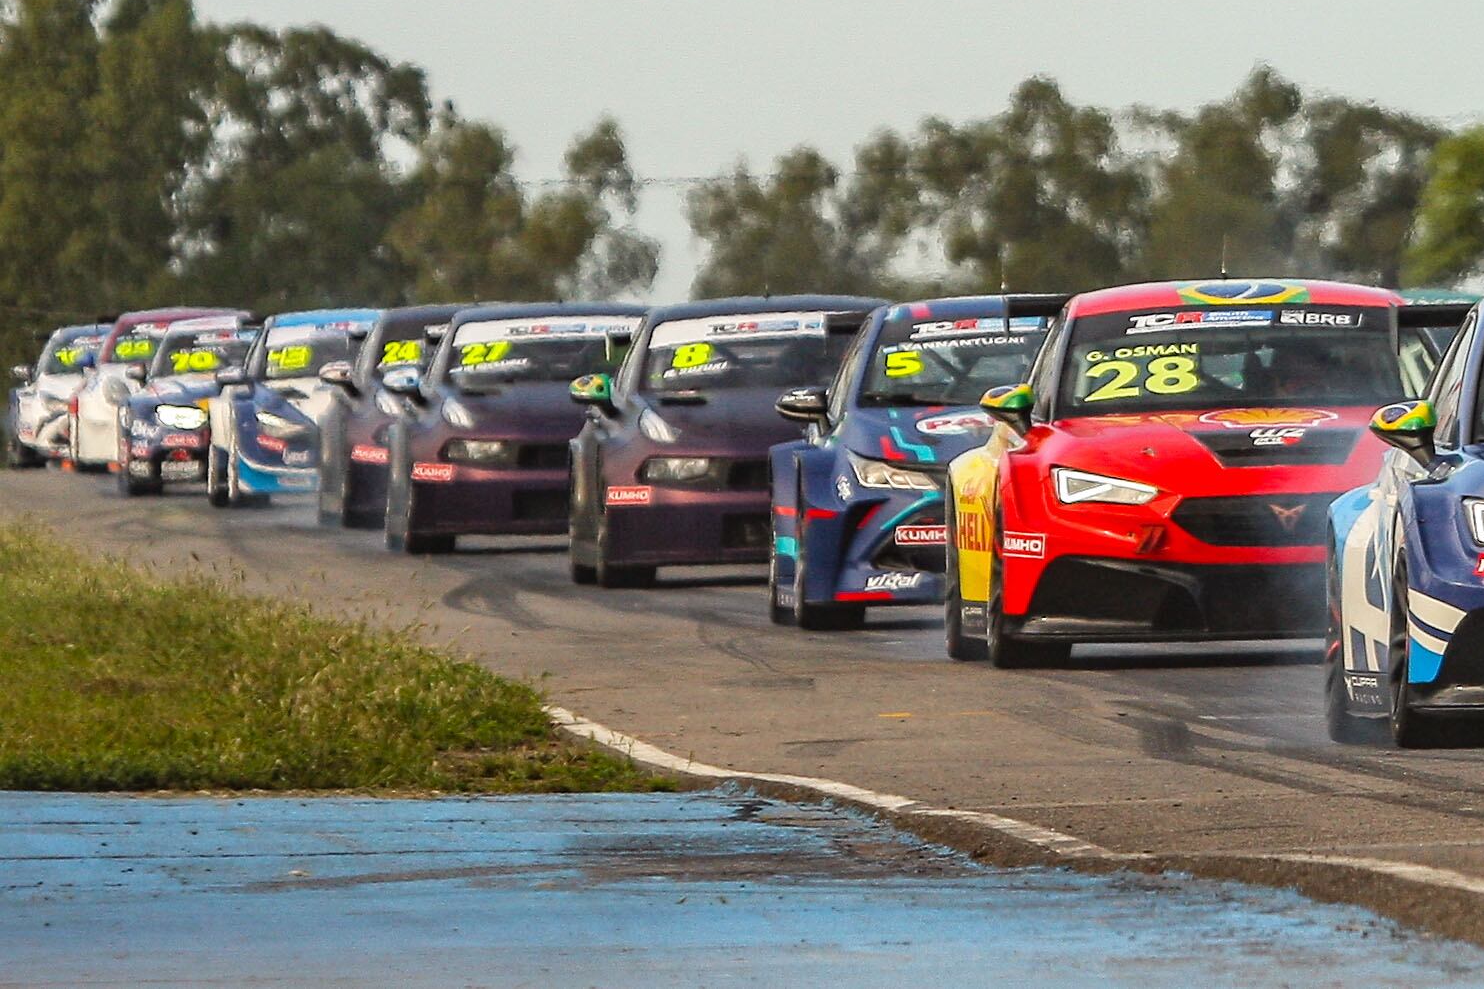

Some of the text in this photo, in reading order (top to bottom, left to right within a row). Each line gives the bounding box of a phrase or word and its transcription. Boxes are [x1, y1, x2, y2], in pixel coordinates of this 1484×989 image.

[1129, 311, 1205, 329] TCR
[1305, 313, 1350, 326] BRB
[382, 340, 421, 363] 24
[461, 340, 512, 365] 27
[672, 342, 713, 368] 8
[1115, 343, 1198, 357] OSMAN
[885, 351, 924, 378] 5
[1084, 356, 1198, 402] 28
[608, 491, 649, 501] KUMHO
[897, 529, 947, 541] KUMH
